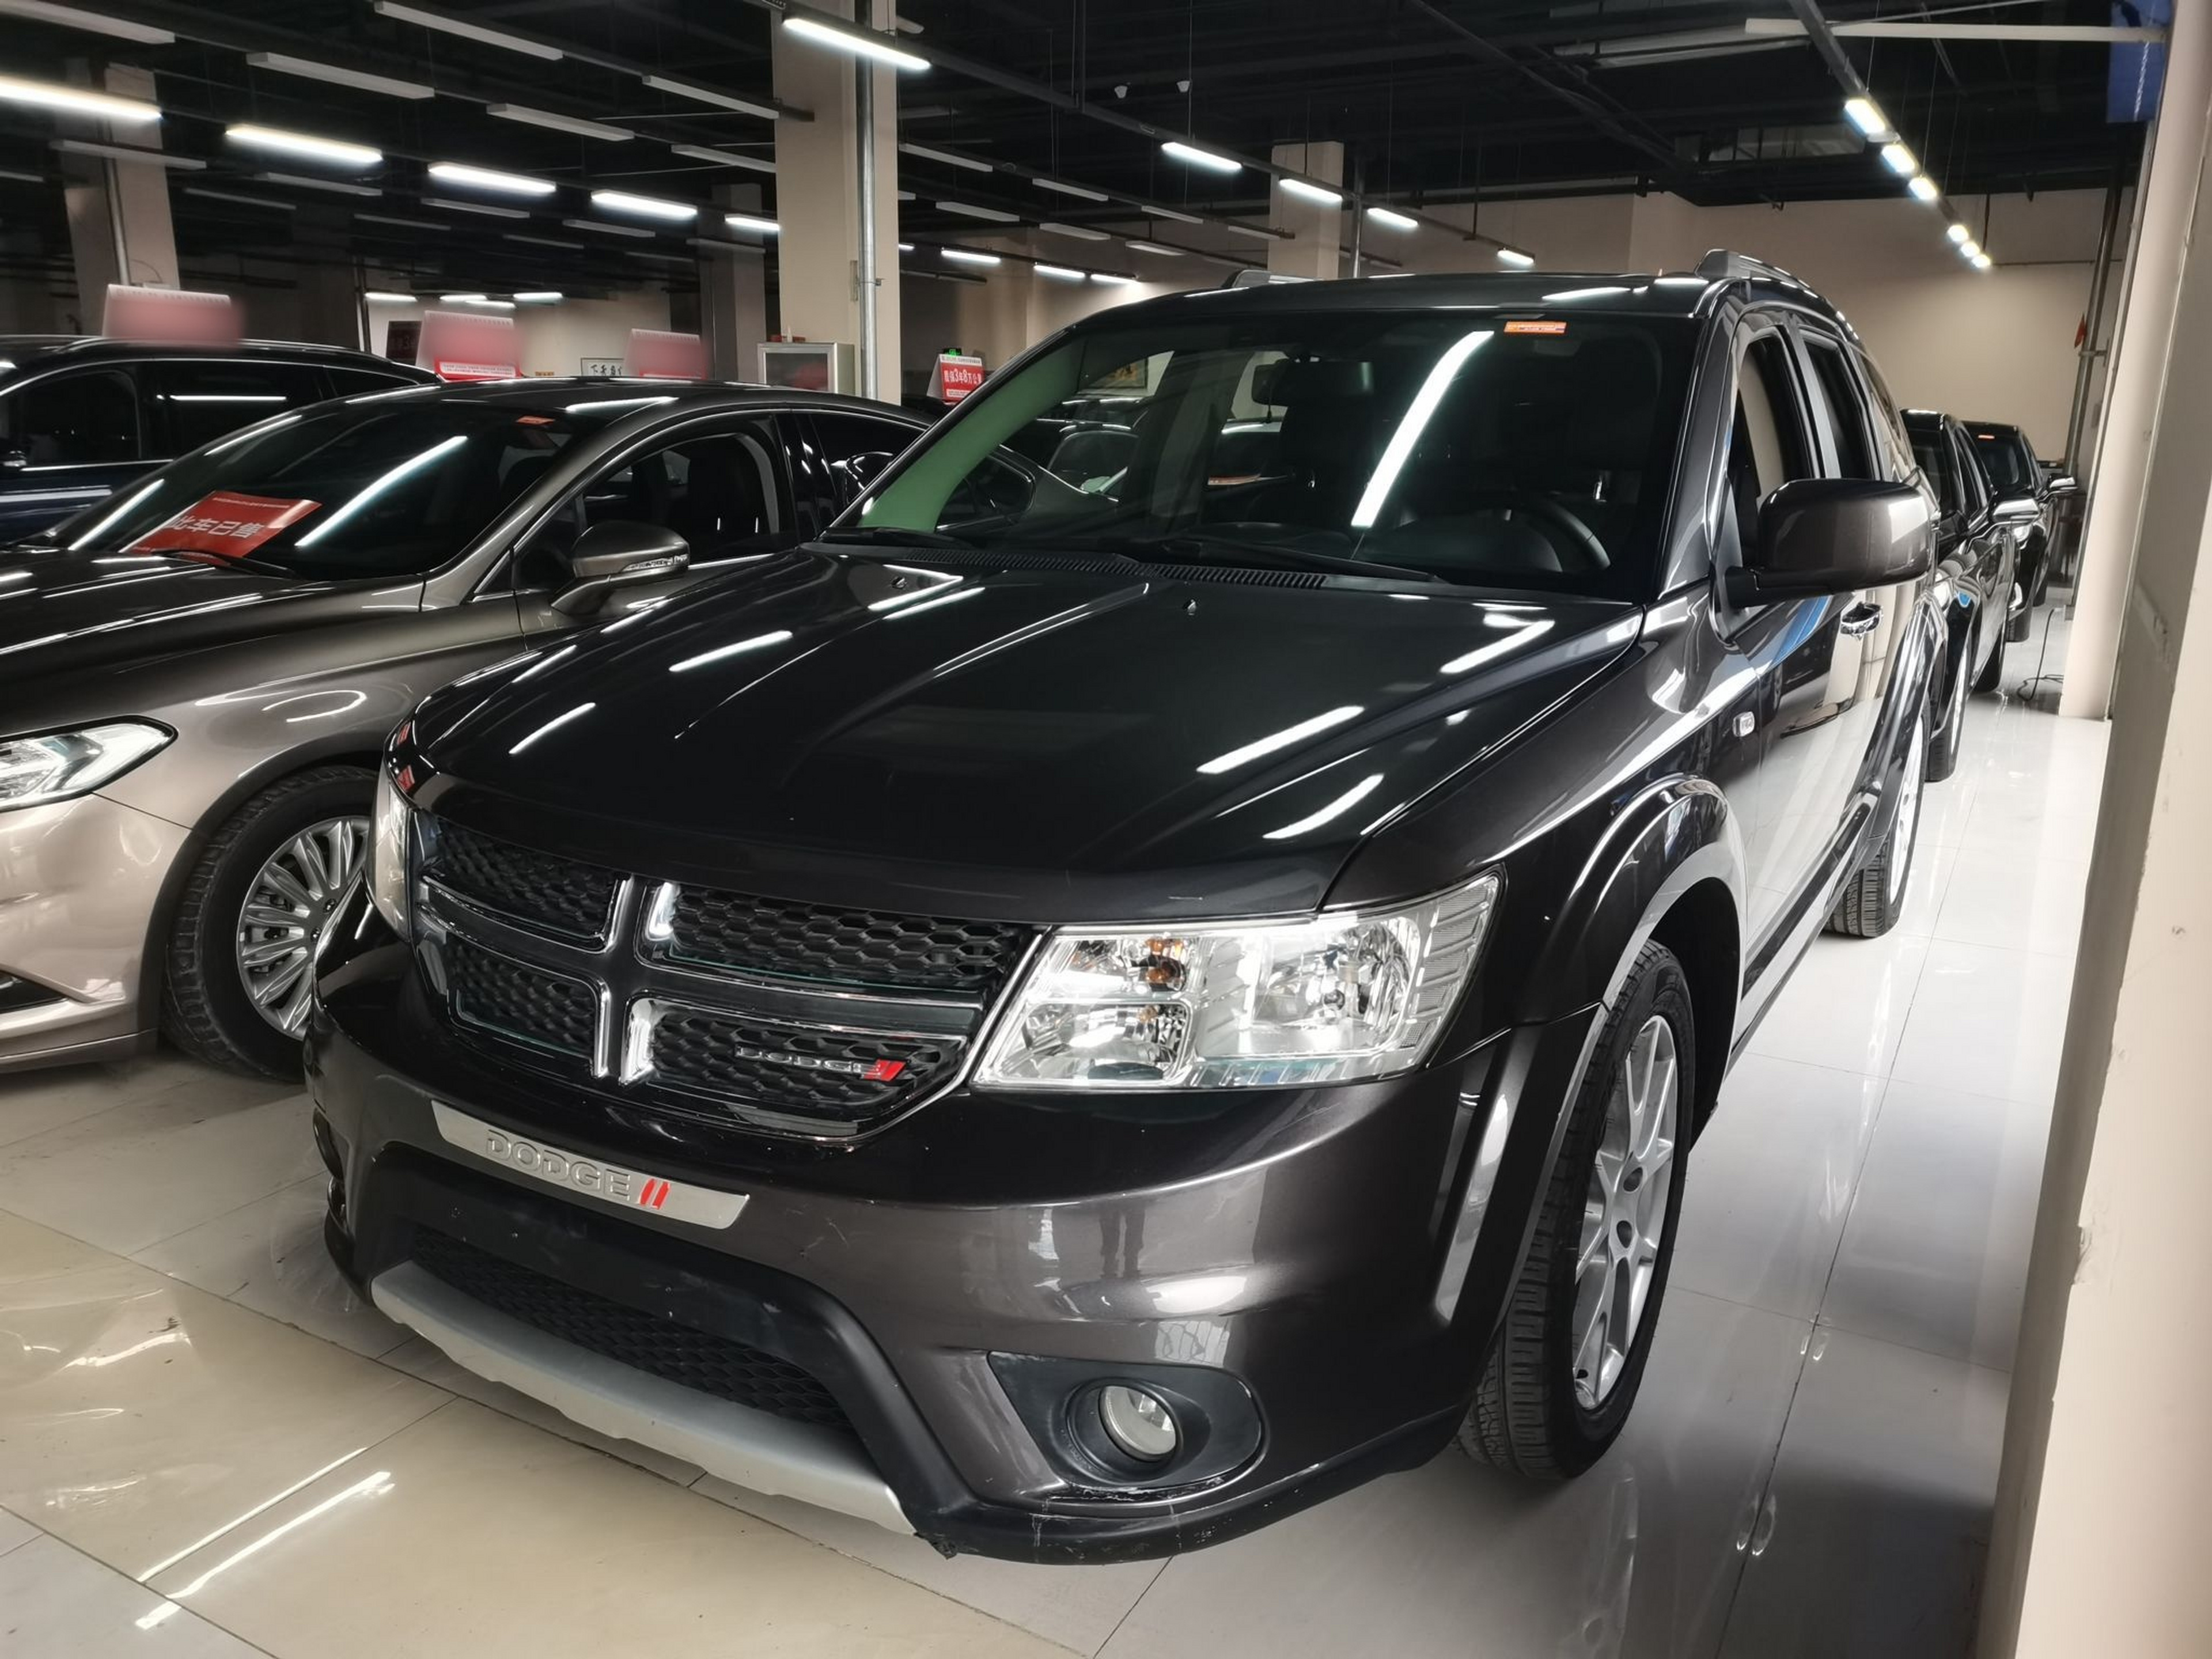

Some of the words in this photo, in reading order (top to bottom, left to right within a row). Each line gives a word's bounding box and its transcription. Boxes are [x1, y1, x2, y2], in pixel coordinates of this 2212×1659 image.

[163, 516, 265, 538] 此车已售
[486, 1130, 631, 1201] DODGE
